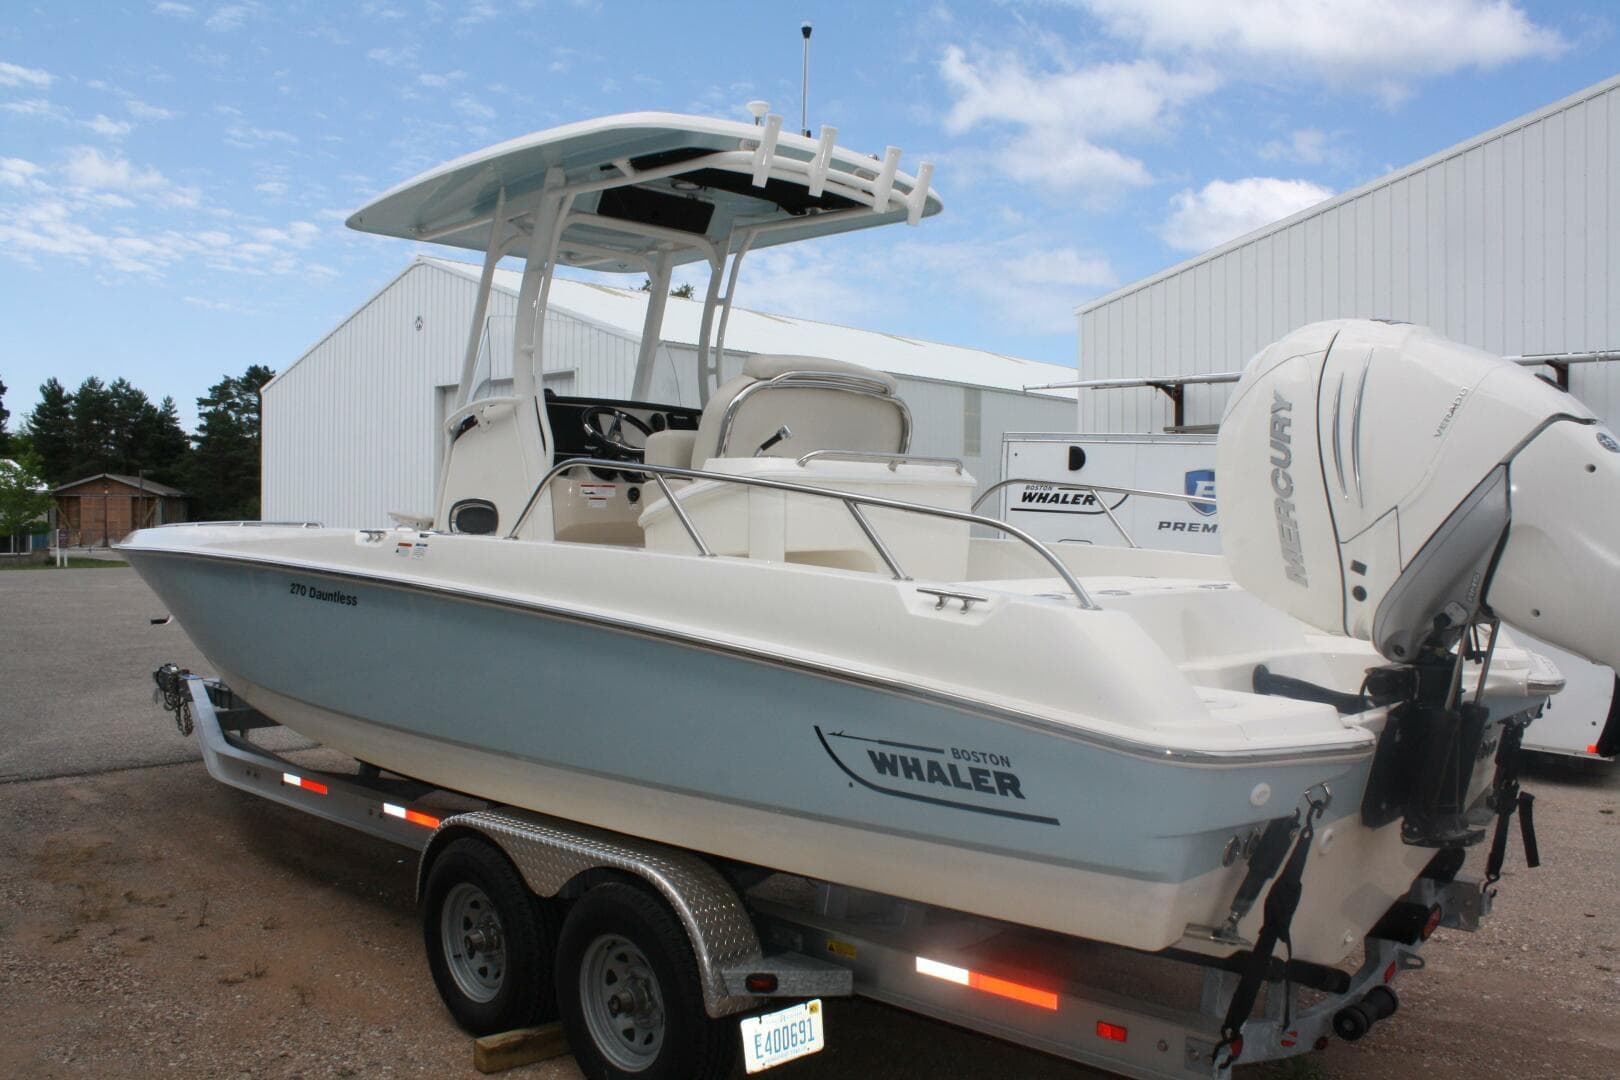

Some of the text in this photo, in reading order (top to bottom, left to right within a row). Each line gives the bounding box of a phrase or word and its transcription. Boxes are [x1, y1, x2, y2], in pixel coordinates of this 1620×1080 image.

[1433, 387, 1468, 437] VERADO
[1021, 492, 1096, 506] WHALER
[1270, 390, 1308, 588] MERCURY
[1158, 521, 1218, 533] PREM
[290, 583, 358, 606] 270 Dauntless
[951, 747, 1011, 768] BOSTON
[866, 750, 1026, 799] WHALER
[754, 1018, 815, 1059] E400691
